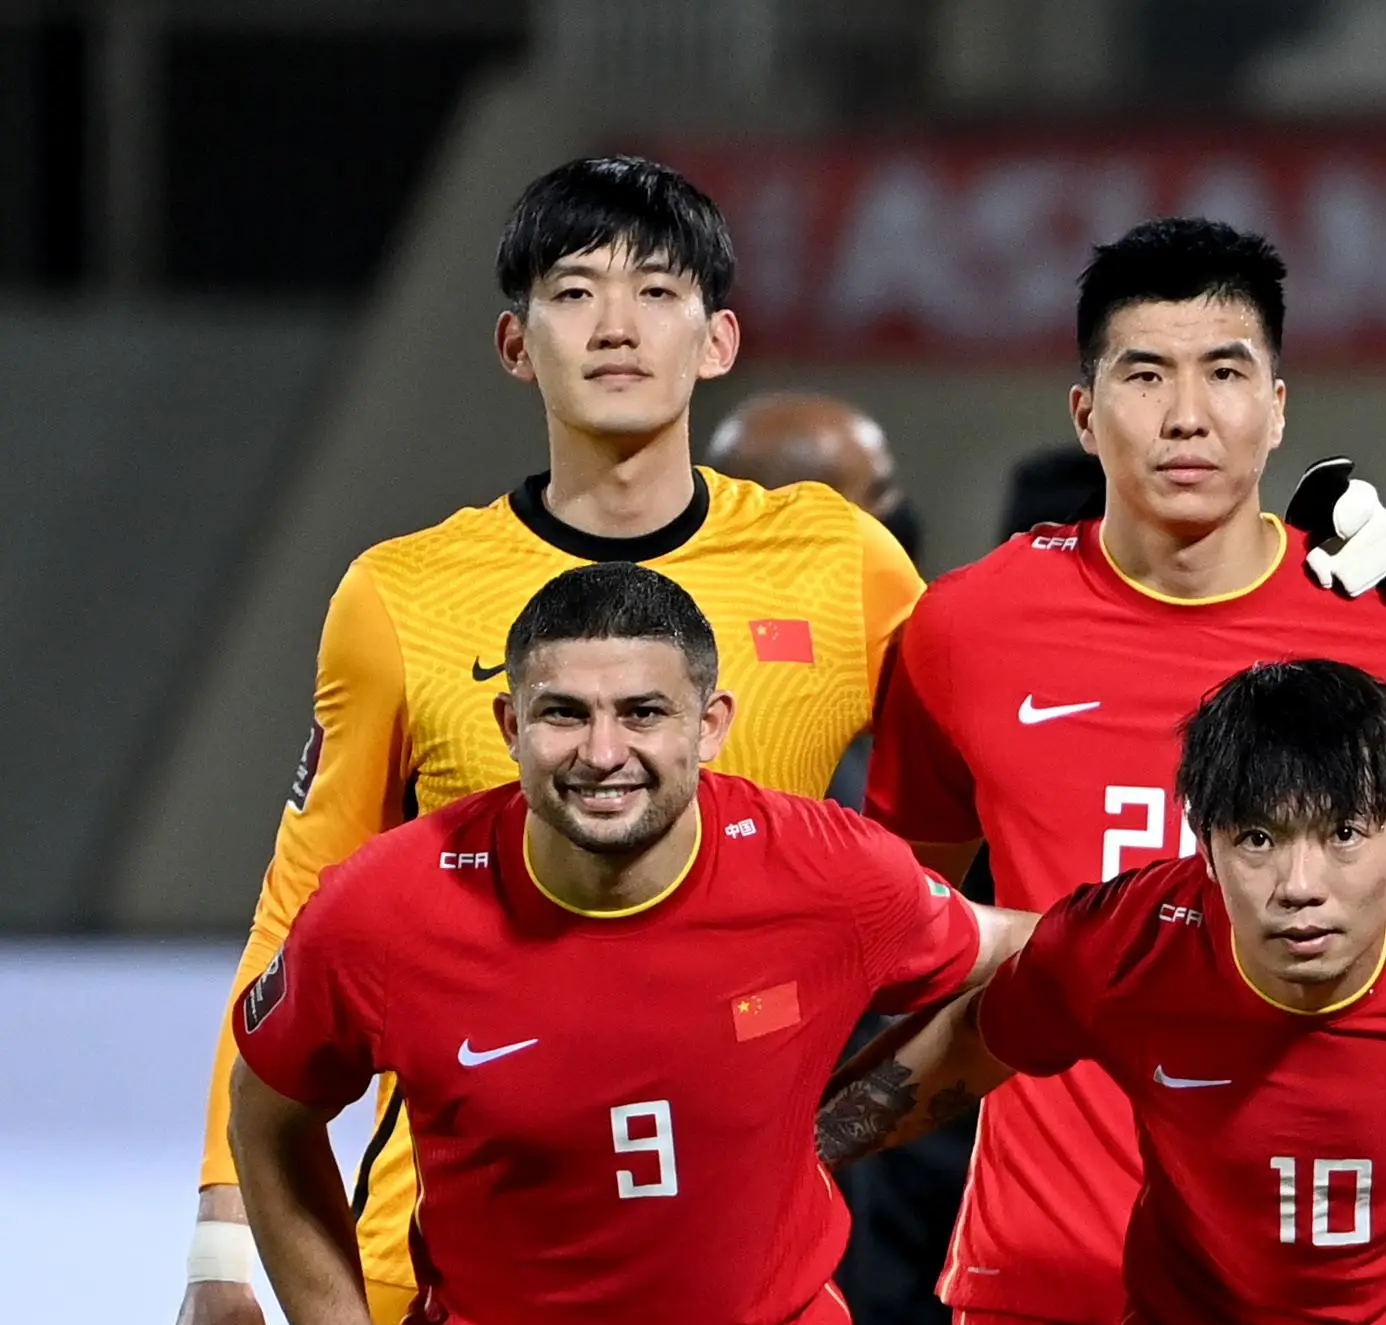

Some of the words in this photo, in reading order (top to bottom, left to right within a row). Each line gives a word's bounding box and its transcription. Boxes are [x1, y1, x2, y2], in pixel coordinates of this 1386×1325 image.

[1031, 535, 1078, 551] CFA
[724, 818, 757, 839] 中国
[438, 851, 489, 869] CFA
[1158, 903, 1204, 928] CFA
[610, 1099, 677, 1198] 9
[1269, 1156, 1373, 1248] 10
